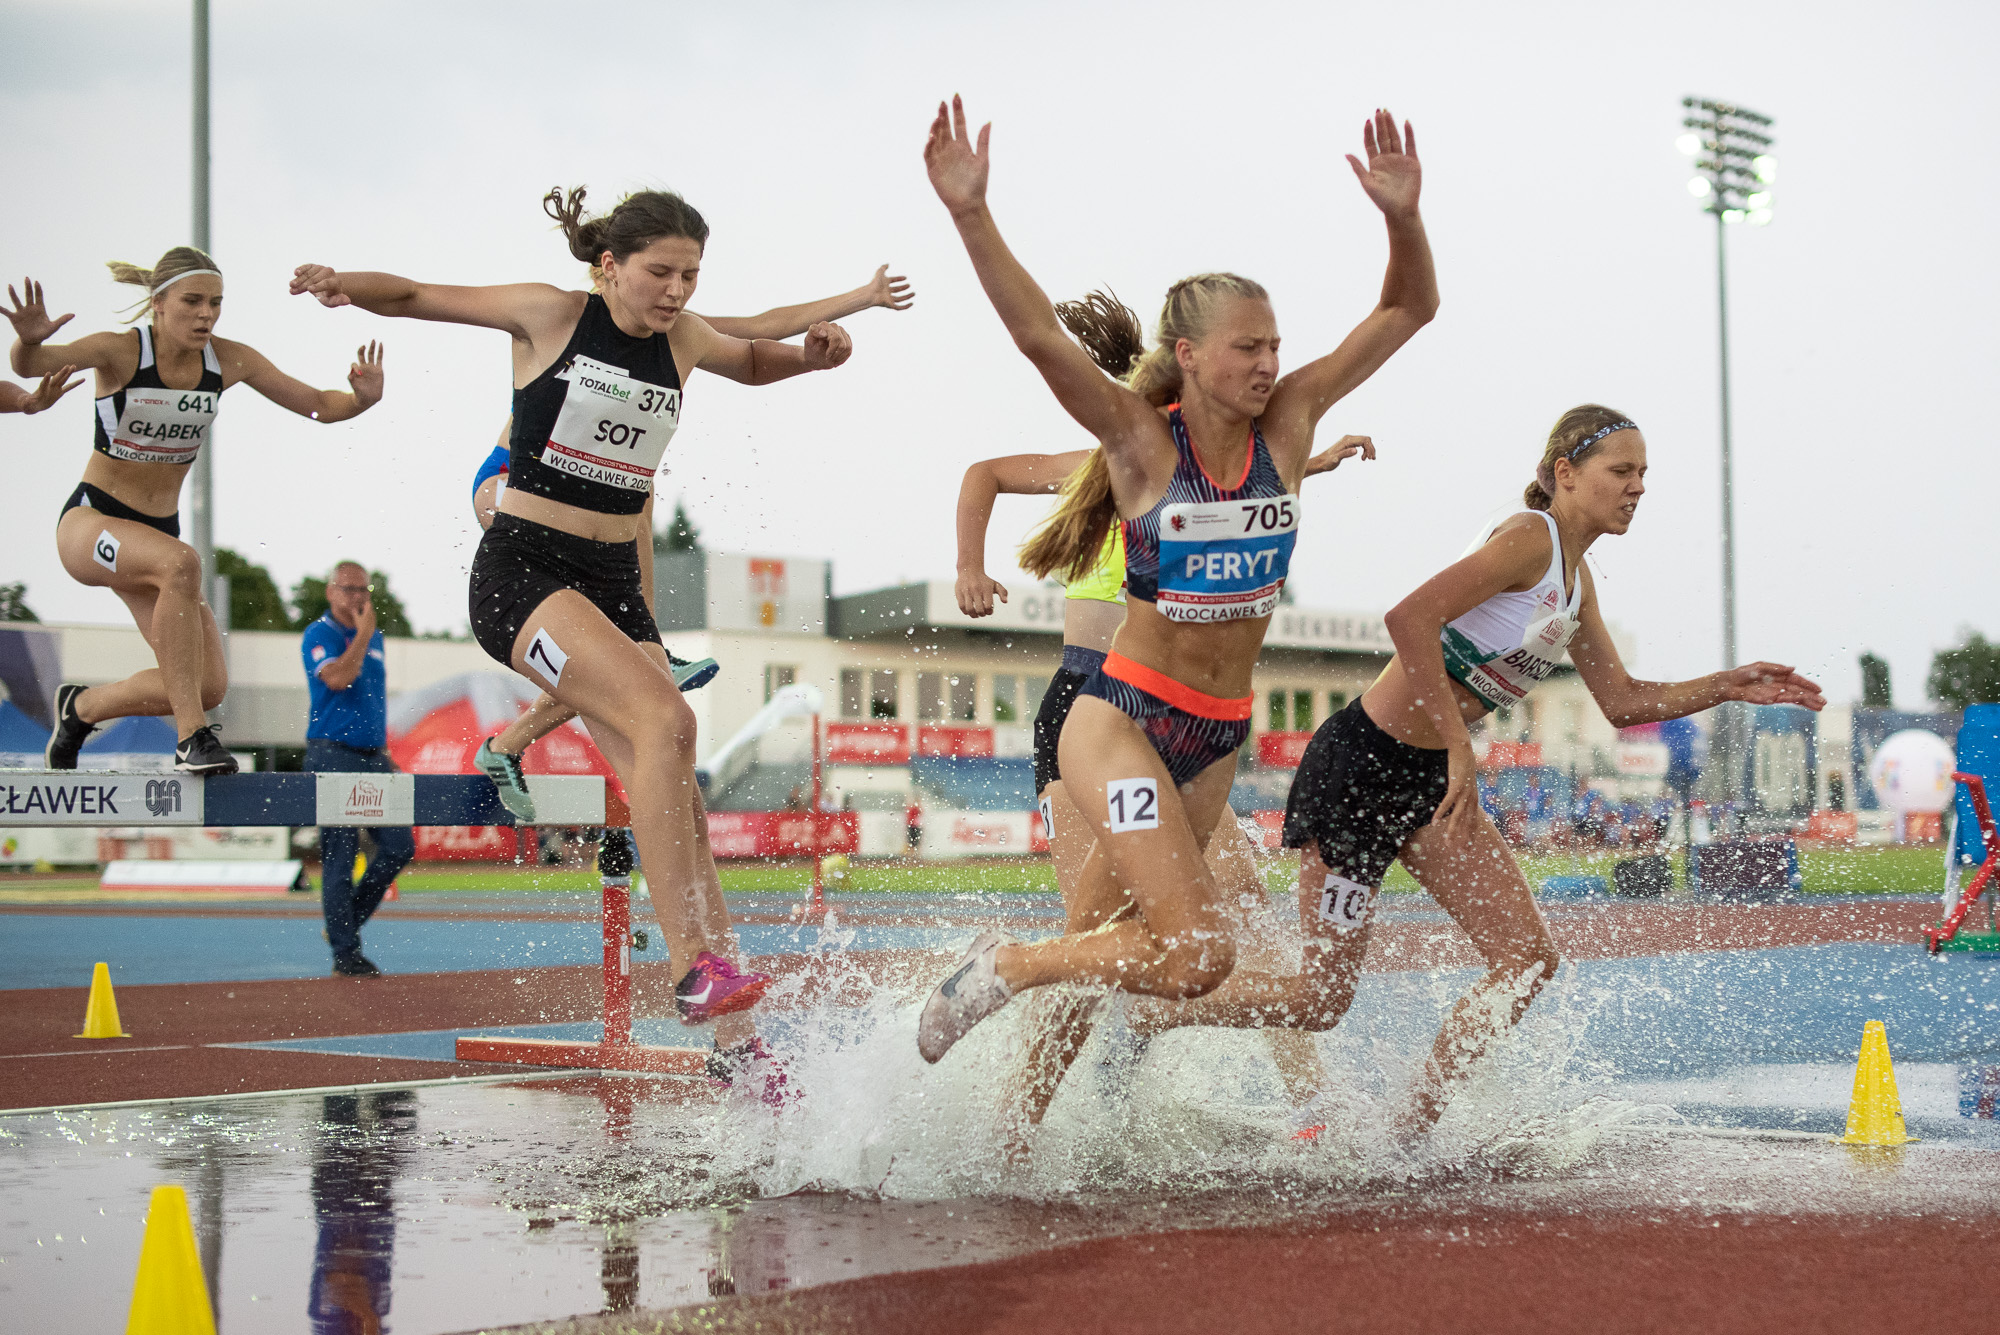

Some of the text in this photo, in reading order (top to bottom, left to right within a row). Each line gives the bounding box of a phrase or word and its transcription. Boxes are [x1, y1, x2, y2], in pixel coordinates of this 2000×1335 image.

[579, 376, 631, 400] TOTALbet
[177, 394, 214, 413] 641
[638, 389, 676, 417] 374
[128, 419, 205, 441] GŁĄBEK
[593, 419, 647, 450] SOT
[115, 446, 175, 463] WŁOCŁAWEK
[565, 448, 583, 459] PZLA
[583, 453, 628, 470] MISTRZOSTWA
[549, 453, 651, 492] WŁOCŁAWEK 202
[1242, 500, 1293, 533] 705
[97, 539, 115, 563] 6
[1185, 547, 1279, 580] PERYT
[1177, 595, 1199, 604] PZLA
[1200, 594, 1255, 604] MISTRZOSTWA
[1165, 605, 1258, 621] WŁOCŁAWEK
[529, 638, 559, 677] 7
[345, 784, 384, 807] Anwil
[1110, 787, 1156, 824] 12
[1325, 884, 1366, 921] 10
